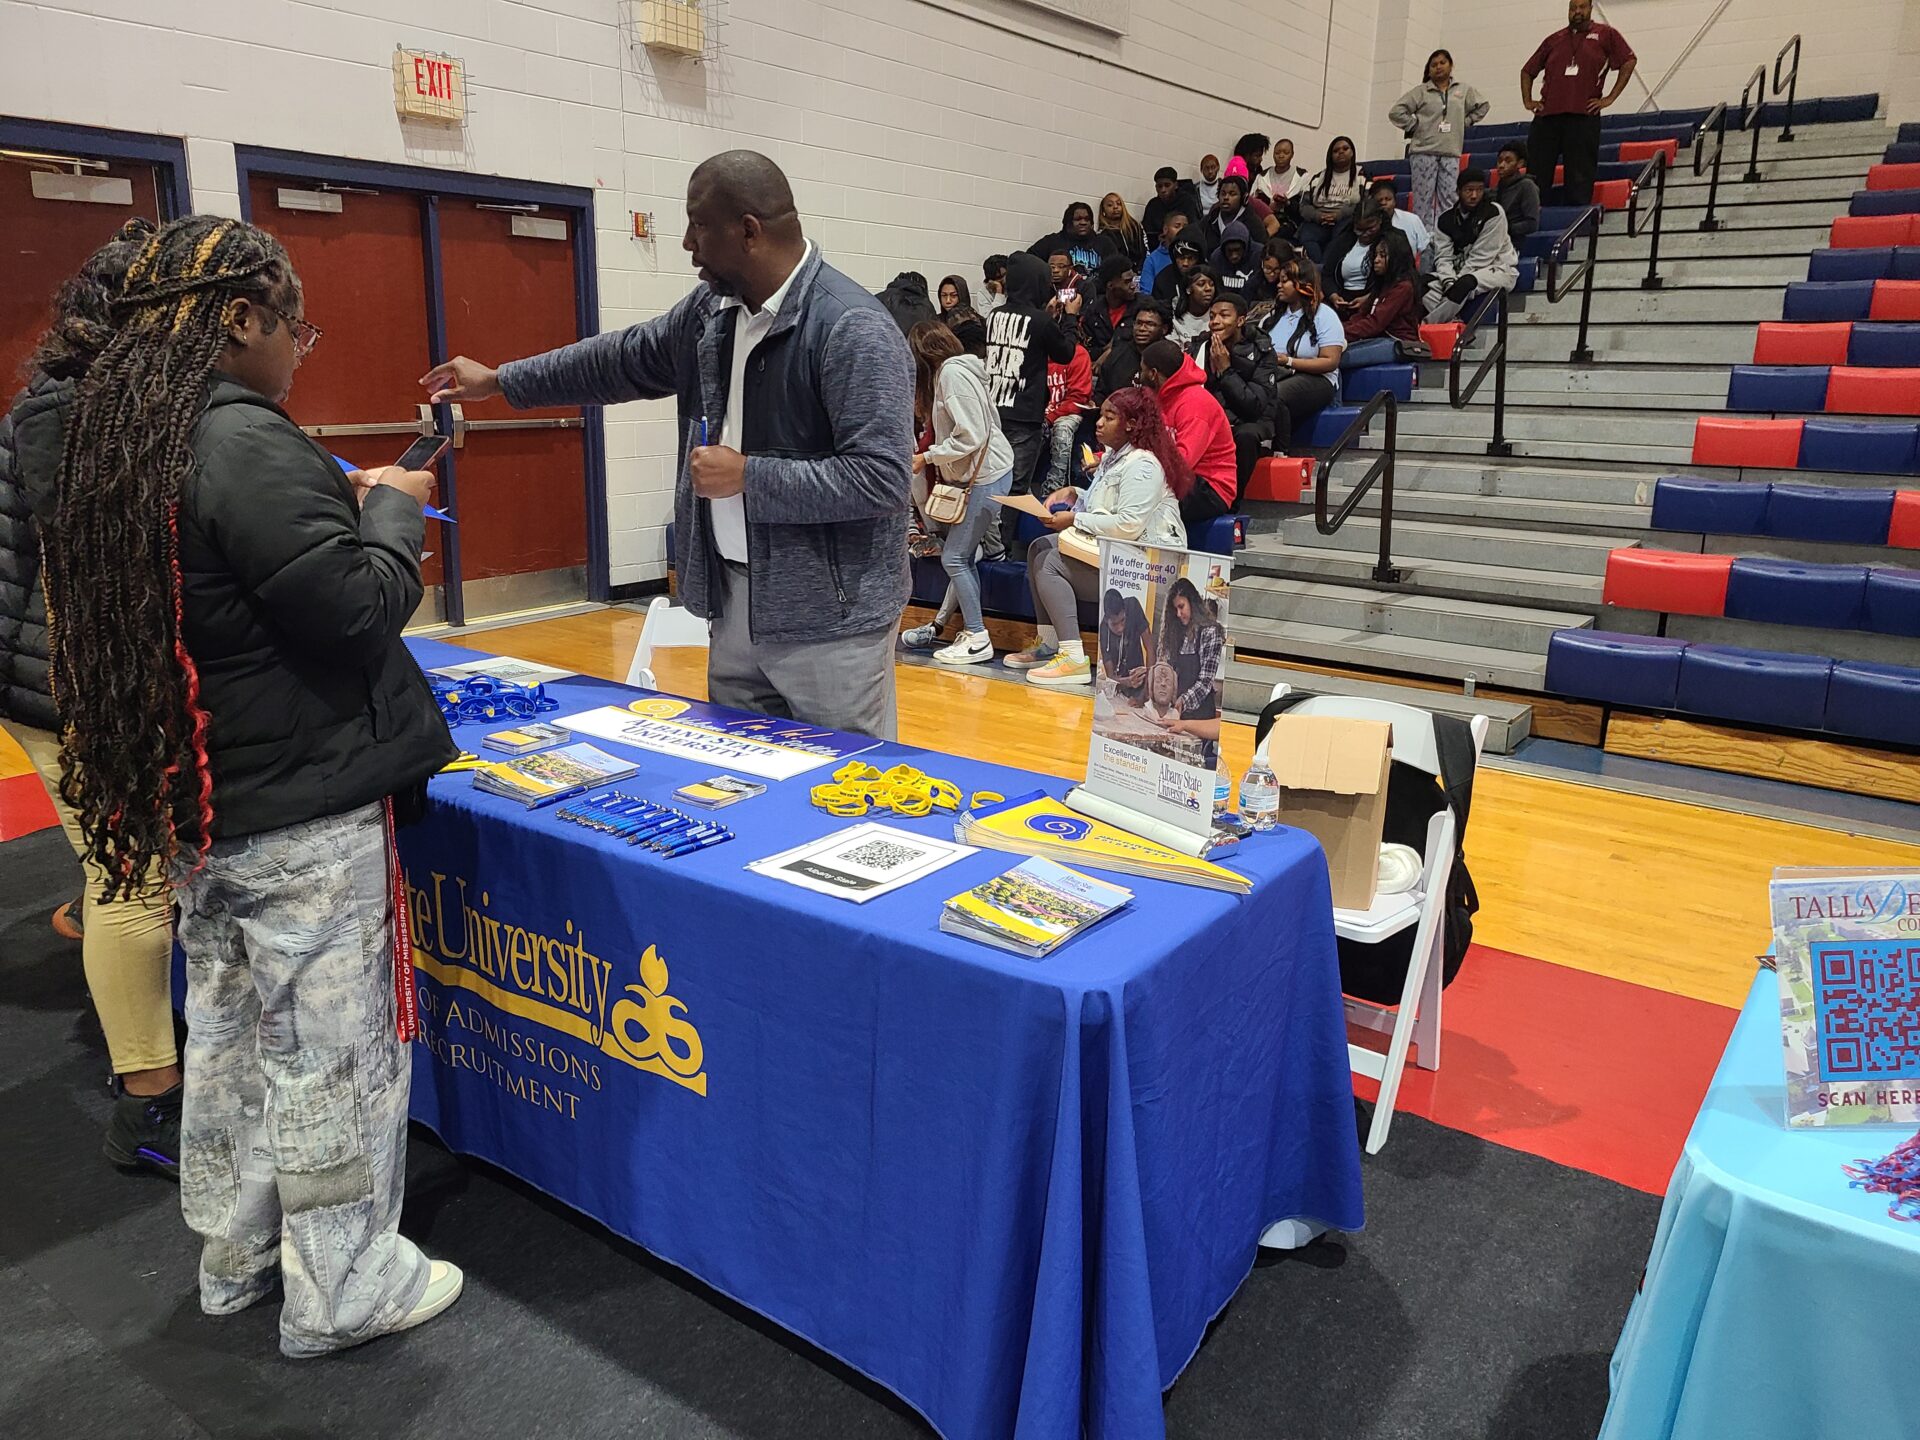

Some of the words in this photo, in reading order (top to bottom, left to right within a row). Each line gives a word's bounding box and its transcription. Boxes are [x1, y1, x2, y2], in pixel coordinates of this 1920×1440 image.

[414, 57, 453, 101] EXIT
[991, 311, 1032, 349] SHALL
[1110, 567, 1168, 585] undergraduate
[1111, 554, 1125, 567] We
[1125, 557, 1144, 570] offer
[1145, 563, 1164, 573] over
[1164, 565, 1176, 575] 40
[1109, 577, 1142, 591] degrees.
[621, 726, 750, 759] UNIVERSITY
[625, 718, 707, 742] ALBANY
[708, 733, 782, 757] STATE
[1103, 743, 1140, 763] Excellence
[1141, 754, 1149, 766] is
[1103, 753, 1115, 765] the
[1158, 762, 1184, 790] Albany
[1183, 770, 1202, 793] State
[1158, 779, 1188, 806] University
[803, 865, 835, 881] Albany
[834, 873, 858, 886] State
[399, 902, 410, 960] MISSISSIPPI
[403, 960, 411, 975] OF
[431, 871, 612, 1047] University
[404, 974, 417, 1030] UNIVERSITY
[417, 986, 441, 1018] OF
[446, 1000, 602, 1092] ADMISSIONS
[417, 1018, 581, 1121] RECRUITMENT
[1818, 1091, 1868, 1108] SCAN
[1876, 1089, 1920, 1106] HERE
